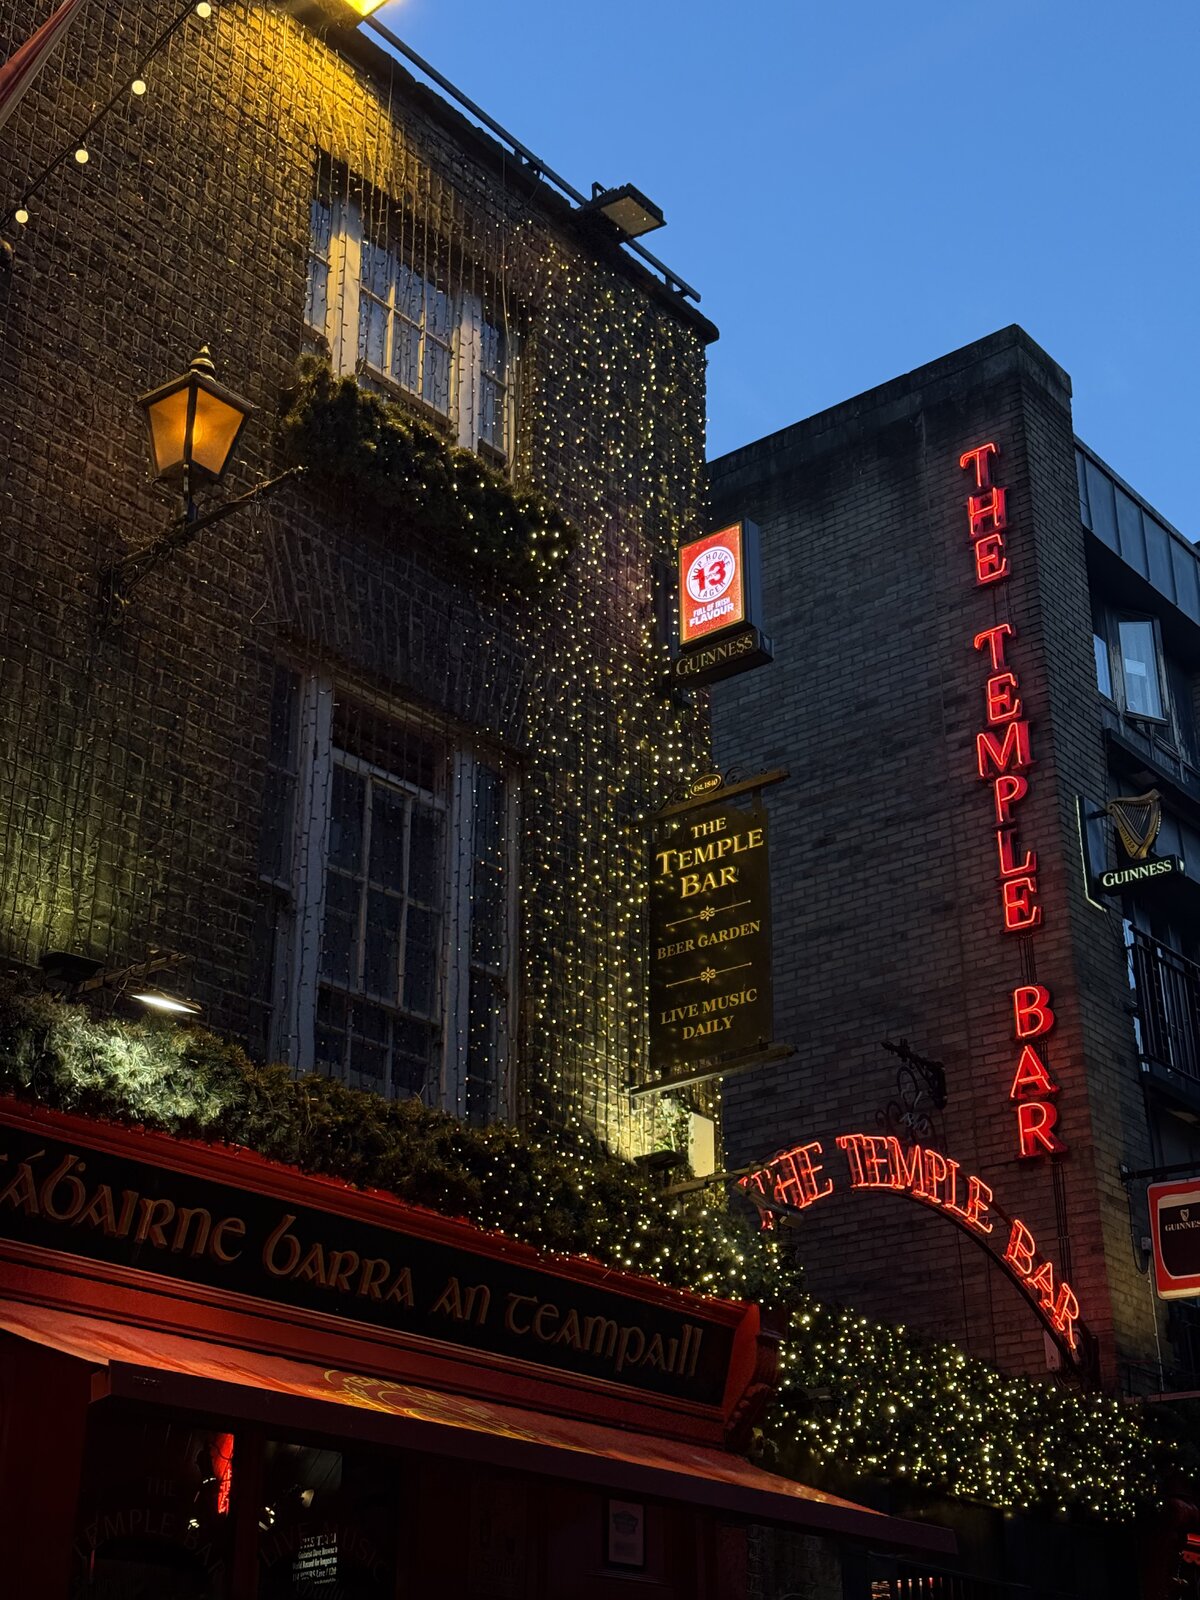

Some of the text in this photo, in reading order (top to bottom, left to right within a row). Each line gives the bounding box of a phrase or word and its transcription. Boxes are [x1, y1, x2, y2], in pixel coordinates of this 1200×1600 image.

[691, 561, 703, 581] HOP
[705, 551, 731, 567] HOUSE
[694, 559, 727, 592] 13
[689, 602, 735, 628] FLAVOUR
[676, 635, 753, 676] GUINNESS
[959, 442, 1066, 1157] THE TEMPLE BAR
[690, 817, 727, 839] THE
[656, 828, 764, 876] TEMPLE
[680, 865, 739, 899] BAR
[1102, 859, 1172, 887] GUINNESS
[657, 920, 761, 960] BEER GARDEN
[660, 988, 758, 1025] LIVE MUSIC
[682, 1015, 735, 1040] DAILY
[738, 1133, 1079, 1350] THE TEMPLE BAR
